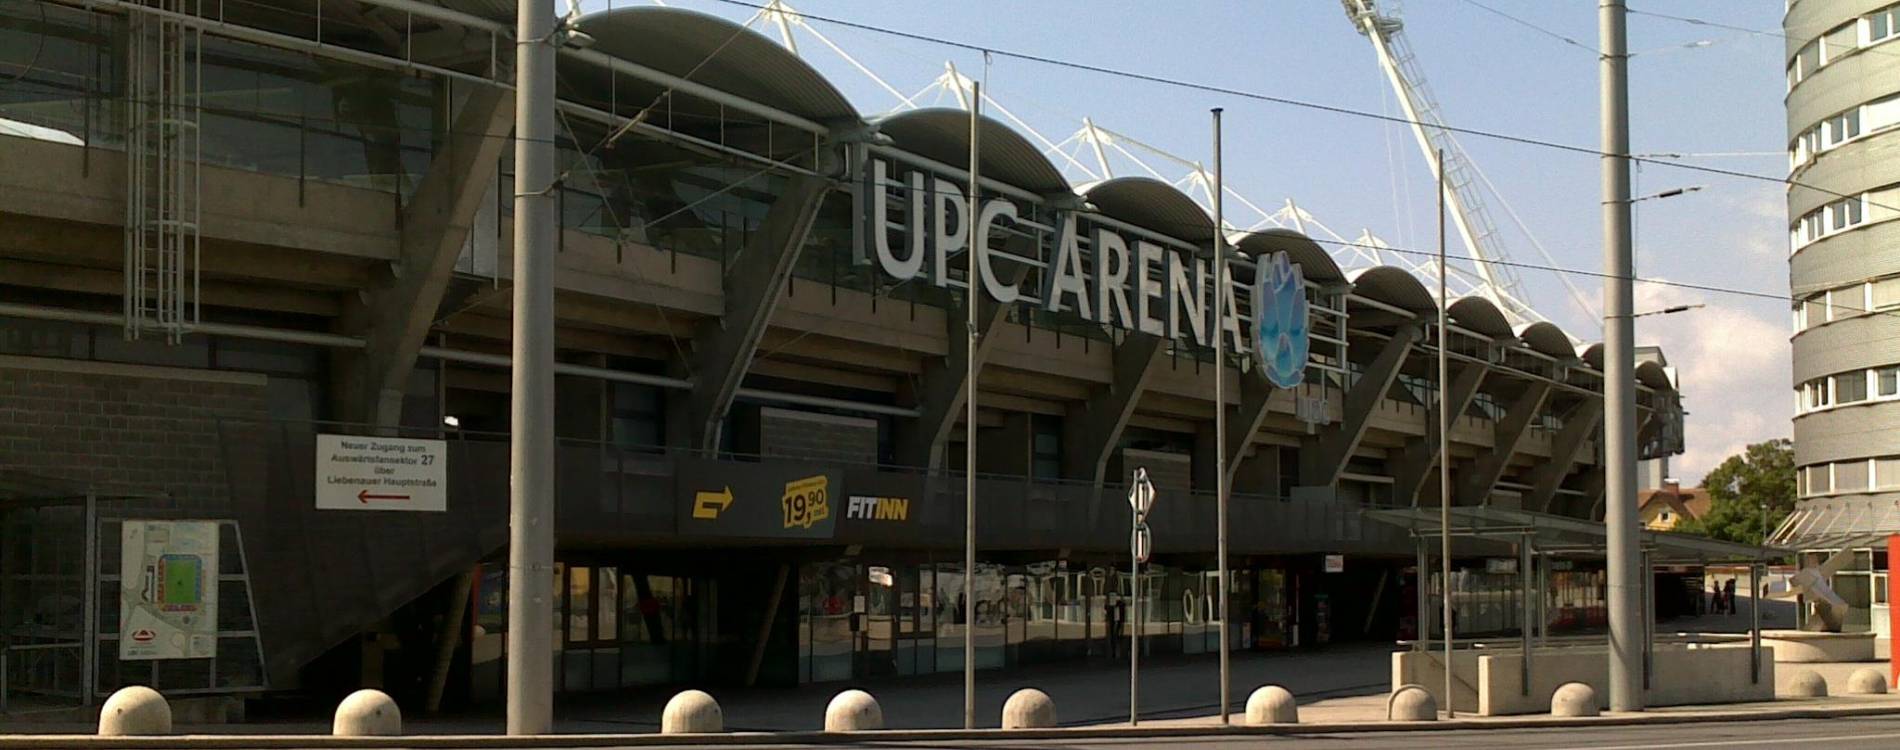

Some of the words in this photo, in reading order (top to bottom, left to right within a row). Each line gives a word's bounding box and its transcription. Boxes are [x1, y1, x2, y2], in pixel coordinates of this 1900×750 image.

[873, 159, 1020, 304] UPC
[1048, 213, 1244, 354] ARENA
[341, 441, 368, 450] Neuer
[370, 442, 405, 453] Zugang
[421, 455, 435, 465] 27
[374, 466, 395, 475] über
[328, 476, 381, 485] Liebenauer
[383, 477, 437, 488] Hauptstraße
[785, 489, 824, 524] 19,90
